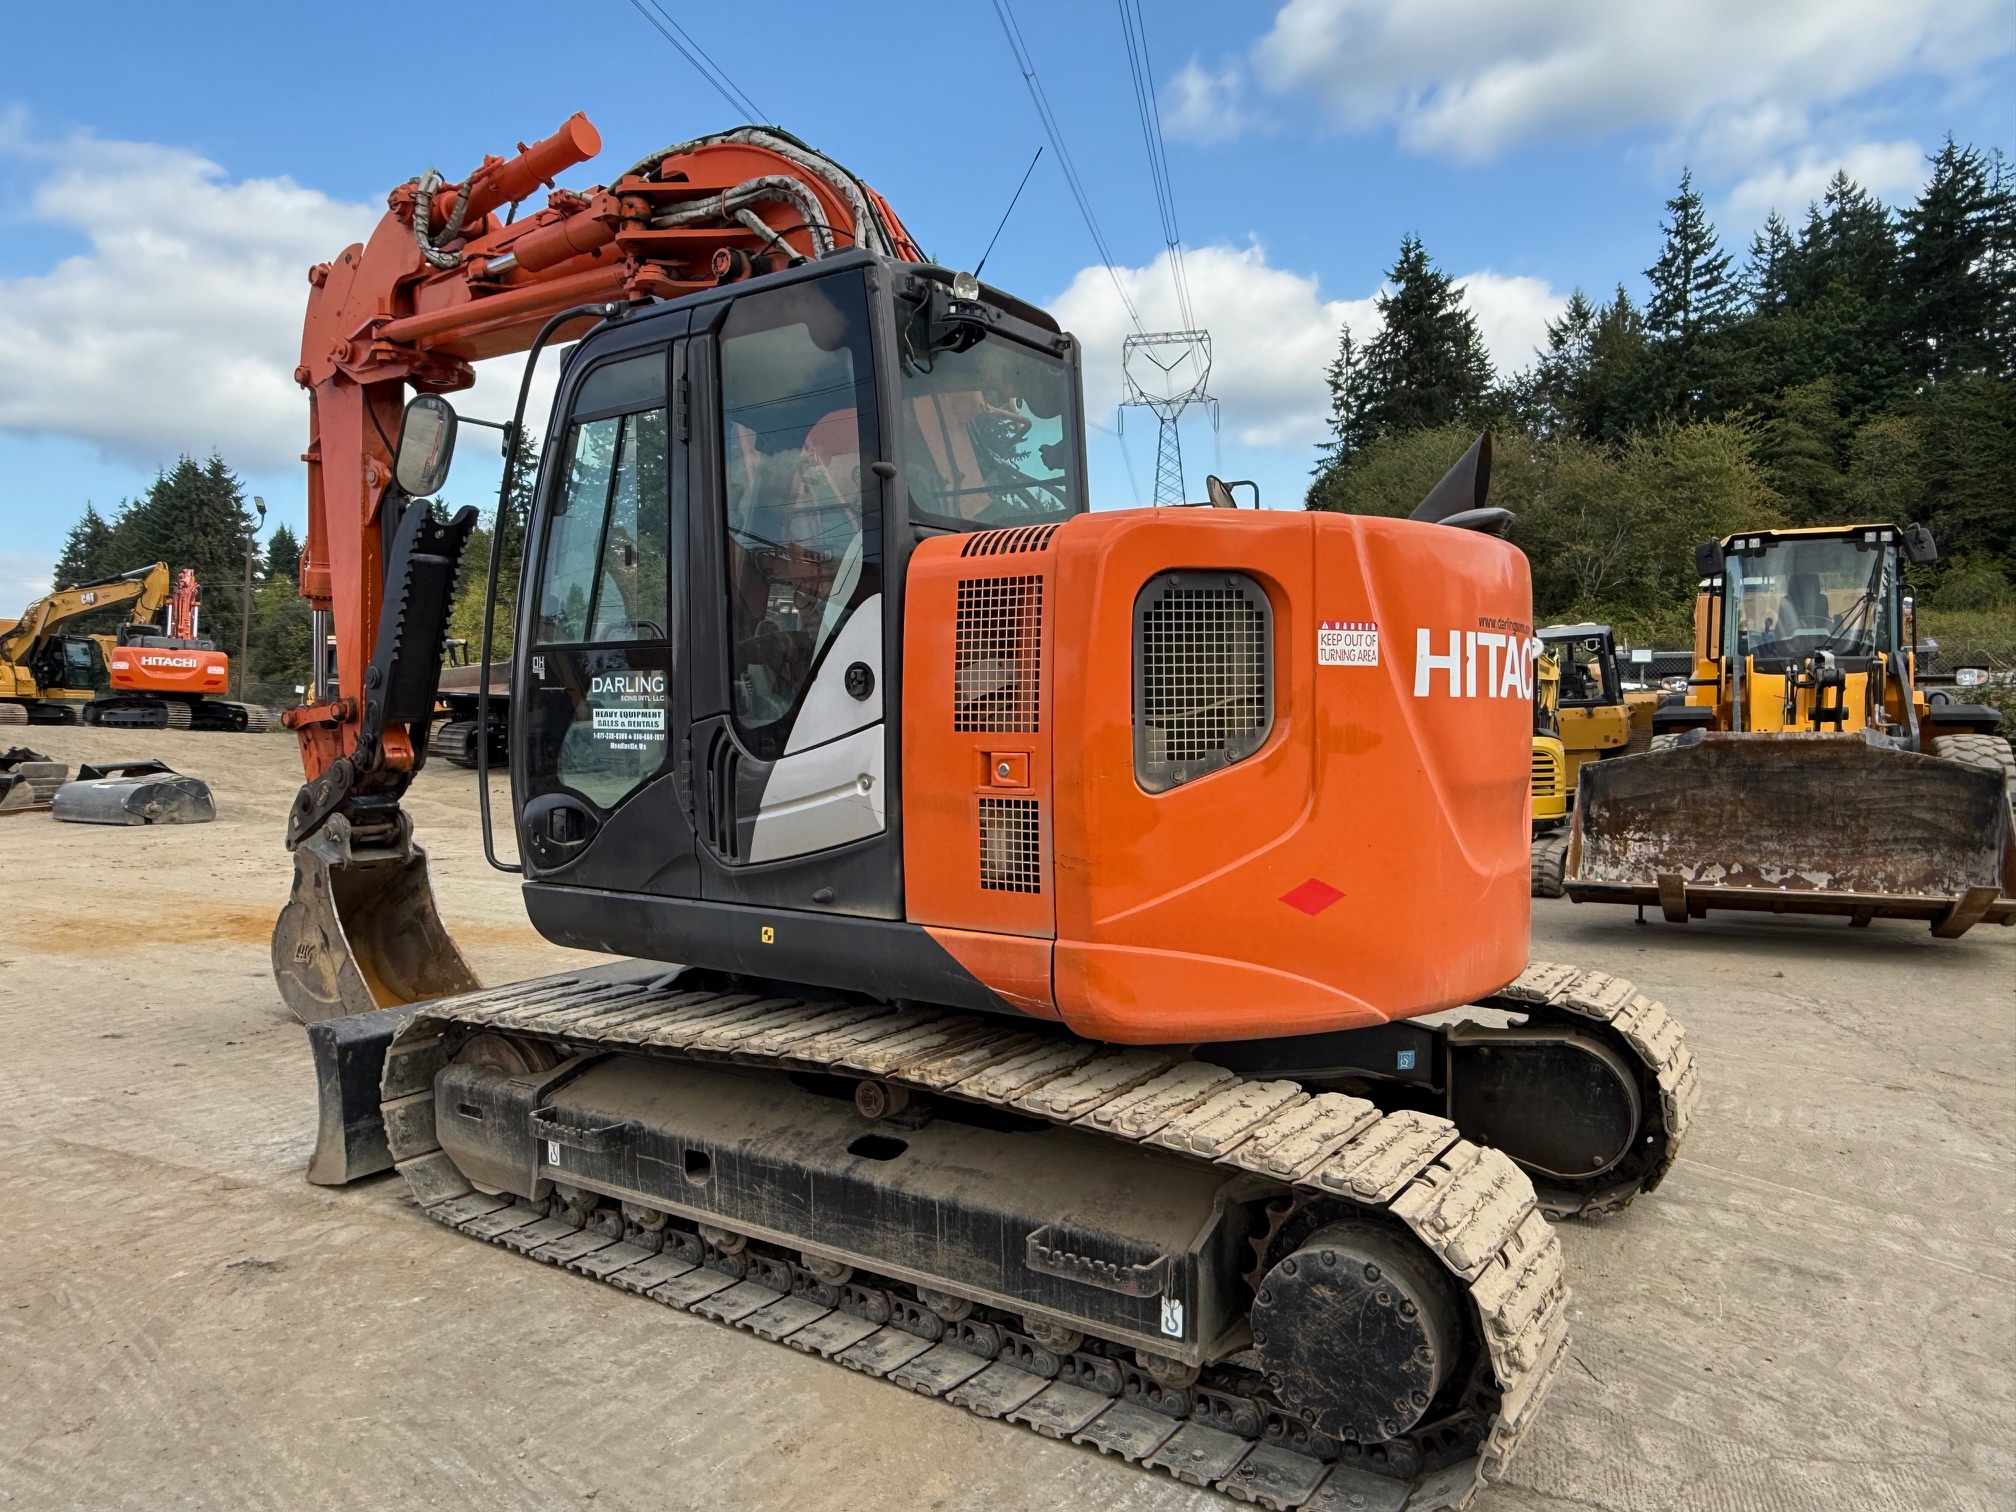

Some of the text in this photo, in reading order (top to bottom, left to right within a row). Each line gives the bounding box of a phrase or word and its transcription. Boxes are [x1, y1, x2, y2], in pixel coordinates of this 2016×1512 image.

[80, 592, 95, 605] CAT
[1320, 633, 1377, 647] KEEP OUT OF
[1320, 648, 1377, 662] TURNING AREA
[141, 656, 197, 668] HITACHI
[592, 676, 664, 693] DARLING
[620, 711, 662, 719] EQUIPMENT
[627, 720, 660, 728] RENTALS
